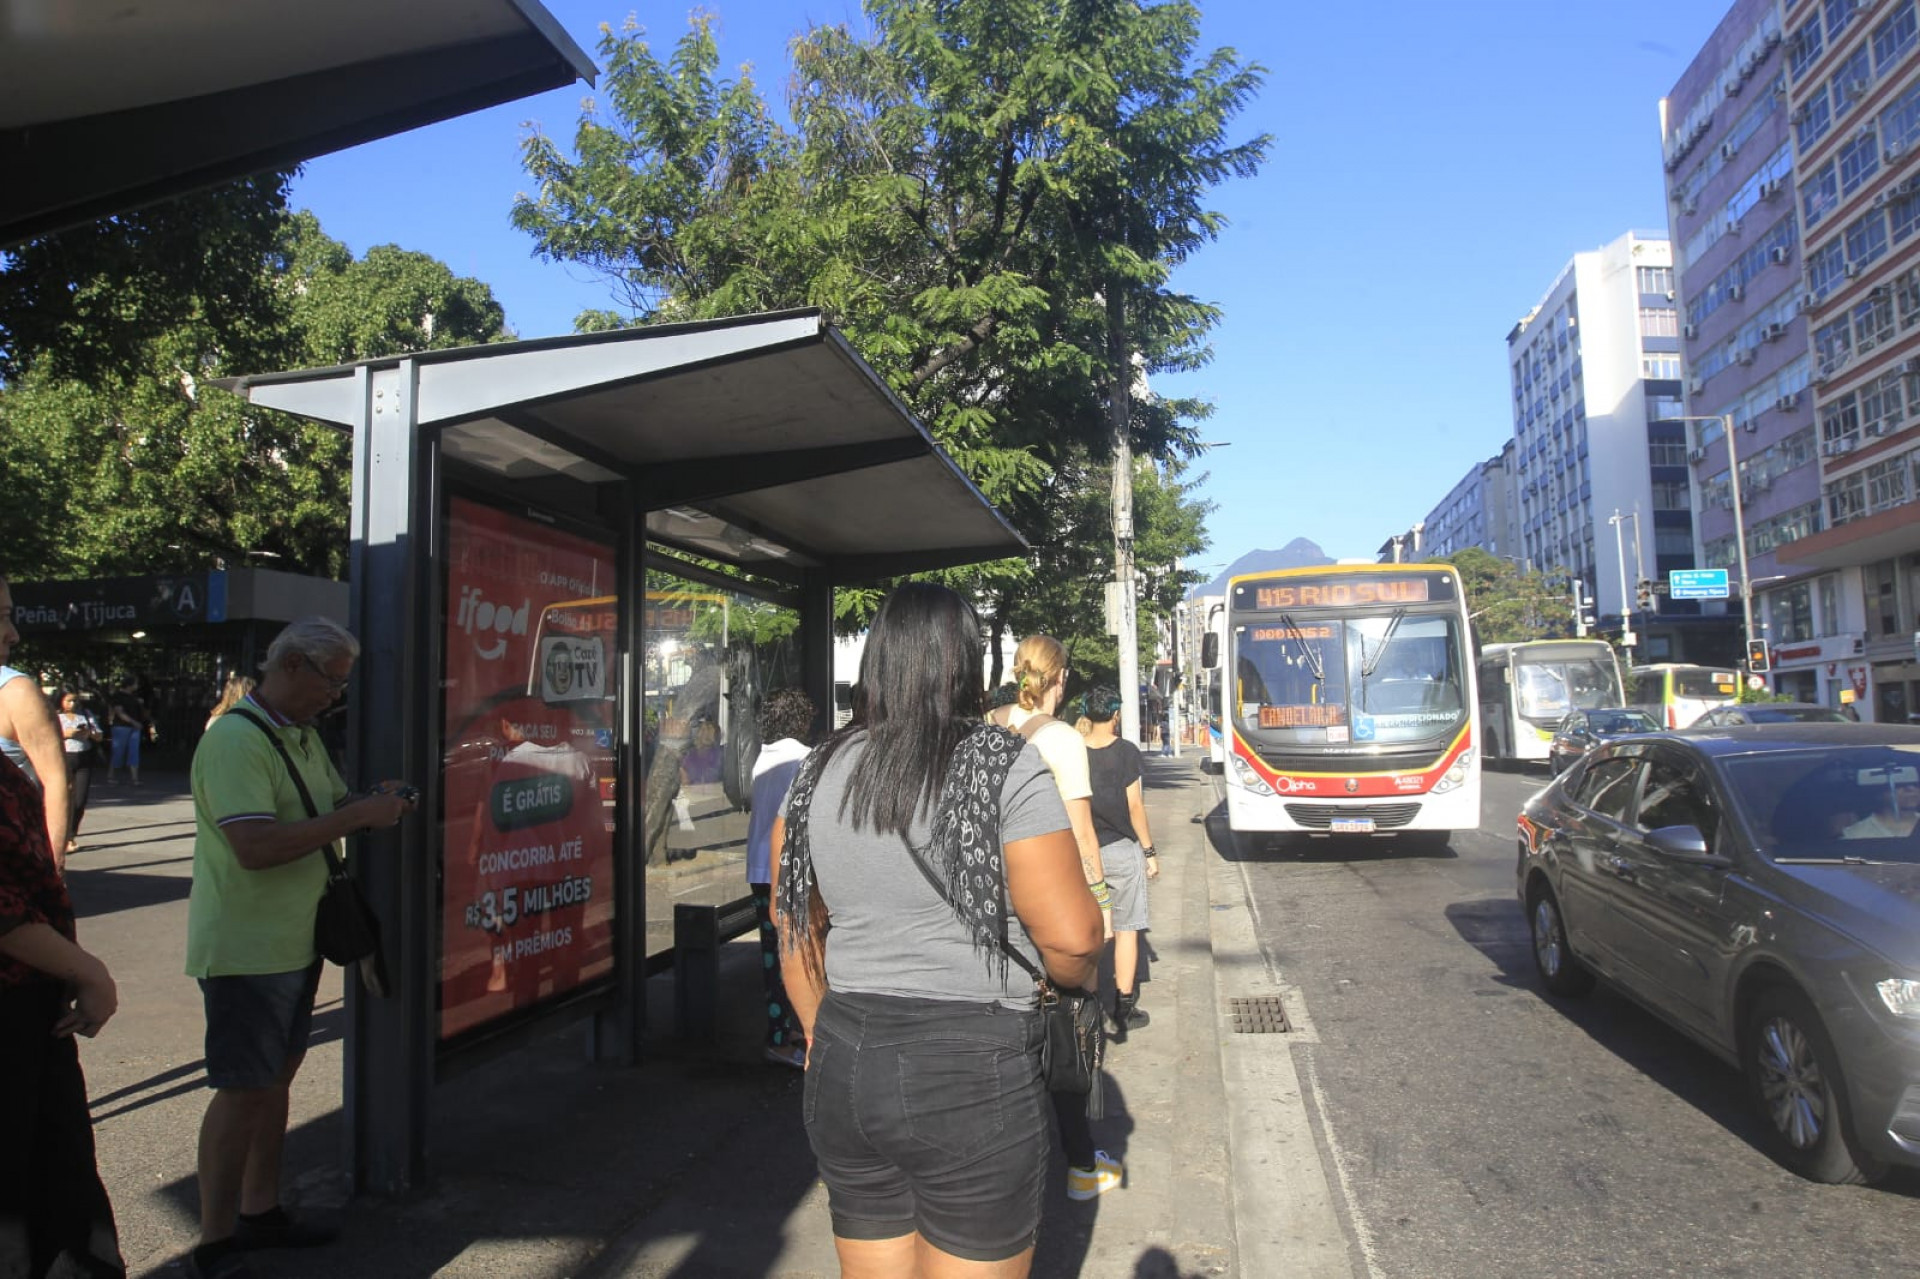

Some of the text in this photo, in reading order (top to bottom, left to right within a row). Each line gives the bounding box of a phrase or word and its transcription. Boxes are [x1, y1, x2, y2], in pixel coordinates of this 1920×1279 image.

[177, 585, 196, 611] A
[1258, 581, 1411, 607] 415 RIO SUL
[15, 605, 57, 624] Peña
[83, 603, 136, 625] Tijuca
[574, 662, 597, 688] TV
[540, 722, 557, 739] SEU
[502, 784, 561, 813] É GRÁTIS
[479, 836, 583, 876] CONCORRA ATÉ
[523, 876, 592, 913] MILHÕES
[516, 927, 573, 959] PRÊMIOS
